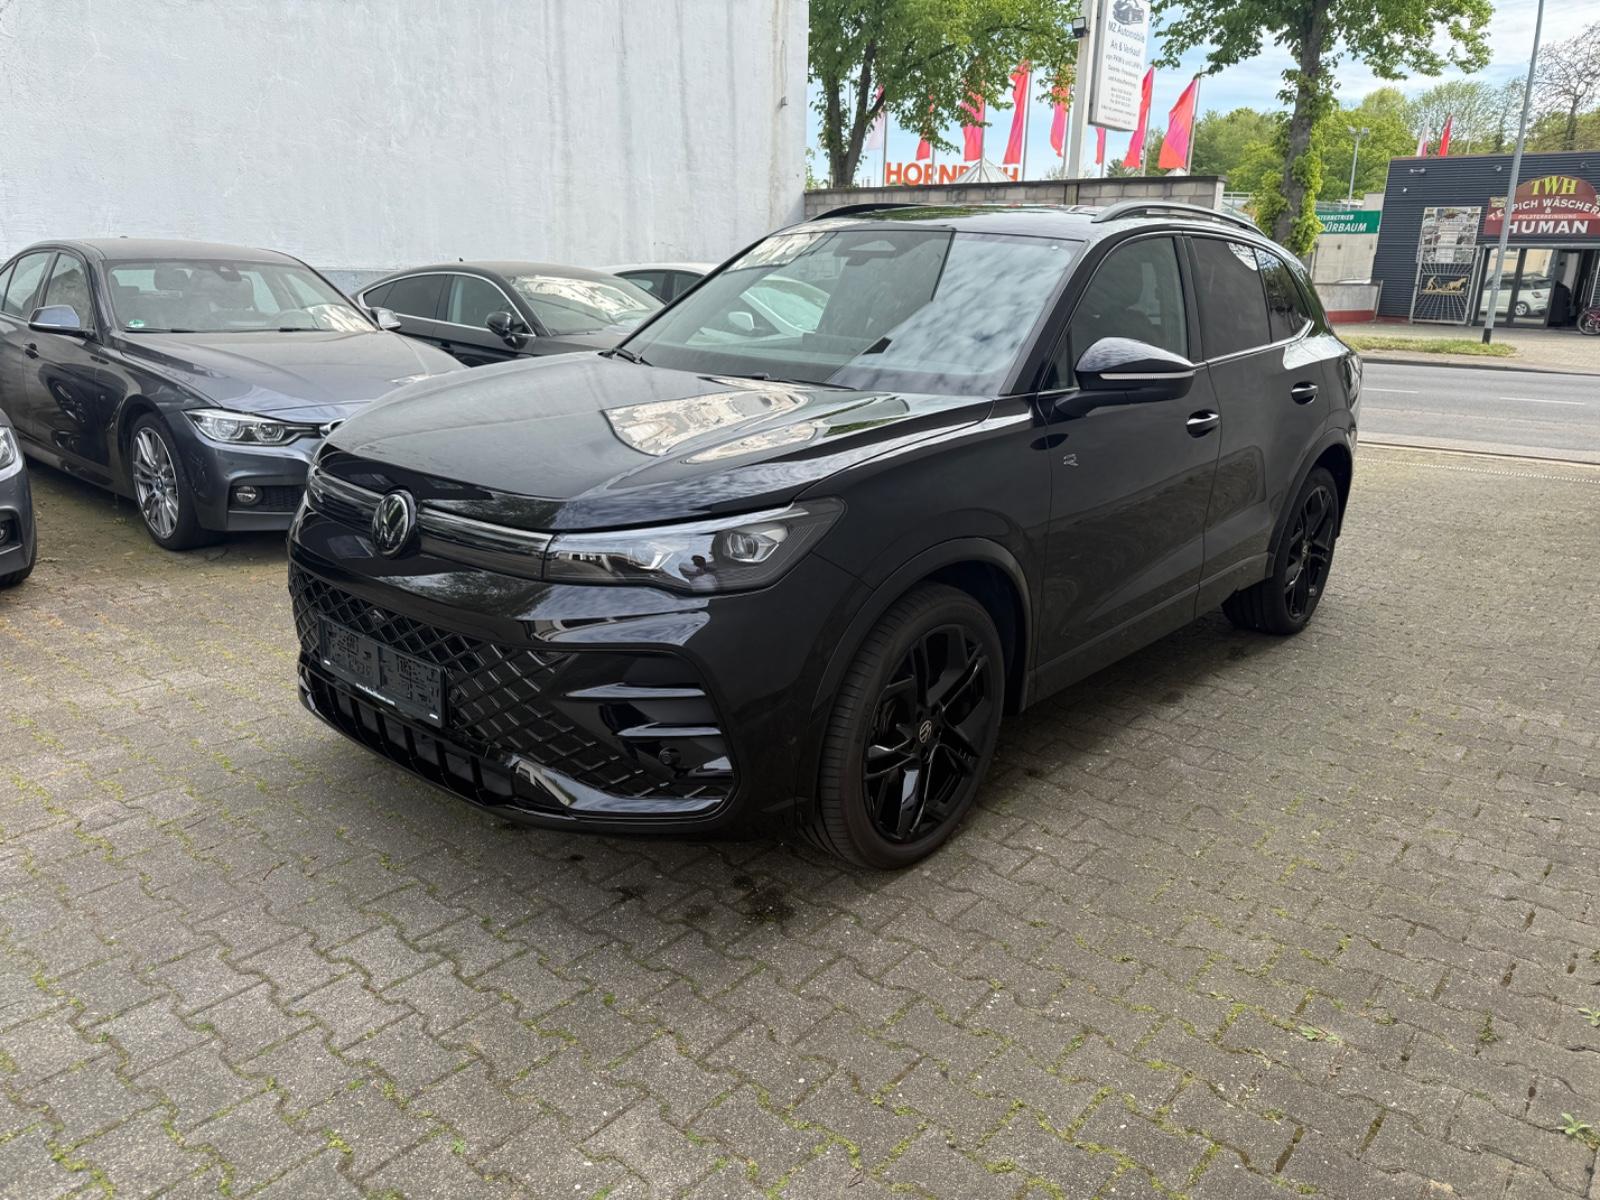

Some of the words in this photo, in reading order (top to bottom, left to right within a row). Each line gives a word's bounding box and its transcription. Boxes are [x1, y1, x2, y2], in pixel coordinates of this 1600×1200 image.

[885, 161, 1019, 186] HORNH
[1531, 175, 1578, 196] TWH
[1488, 199, 1539, 221] TEPICH
[1542, 195, 1600, 218] WÄSCHER
[1325, 221, 1368, 232] ÜRBAUM
[1508, 220, 1589, 234] HUMAN
